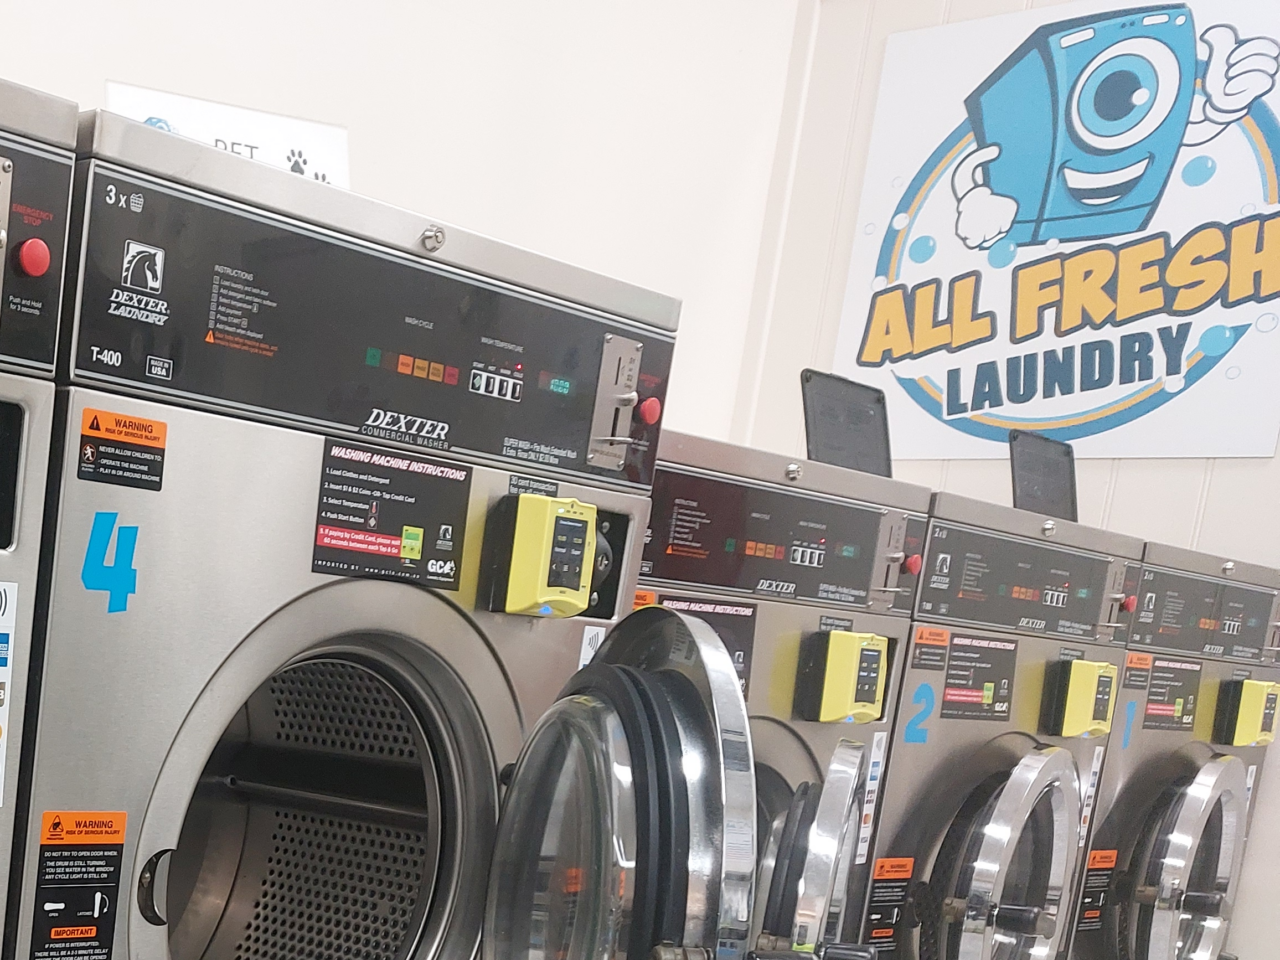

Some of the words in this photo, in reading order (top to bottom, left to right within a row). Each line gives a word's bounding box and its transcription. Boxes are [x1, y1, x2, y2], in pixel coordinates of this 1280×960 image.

[105, 185, 116, 205] 3
[12, 204, 54, 221] EMERGENCY
[23, 216, 42, 226] STOP
[214, 264, 254, 281] INSTRUCTIONS
[856, 270, 997, 367] ALL
[1009, 212, 1280, 344] FRESH
[109, 288, 168, 314] DEXTER
[108, 303, 169, 326] LAUNDRY
[91, 346, 121, 367] T-400
[151, 365, 167, 376] USA
[946, 322, 1192, 417] LAUNDRY
[115, 418, 153, 433] WARNING
[365, 408, 449, 440] DEXTER
[361, 425, 414, 443] COMMERCIAL
[417, 437, 449, 450] WASHER
[330, 446, 371, 463] WASHING
[371, 454, 410, 470] MACHINE
[409, 462, 467, 481] INSTRUCTIONS
[81, 512, 139, 613] 4
[756, 579, 796, 593] DEXTER
[662, 600, 689, 610] WASHING
[689, 603, 714, 613] MACHINE
[714, 605, 753, 616] INSTRUCTIONS
[904, 683, 935, 743] 2
[1122, 701, 1137, 750] 1
[75, 820, 113, 829] WARNING
[54, 928, 94, 936] IMPORTANT
